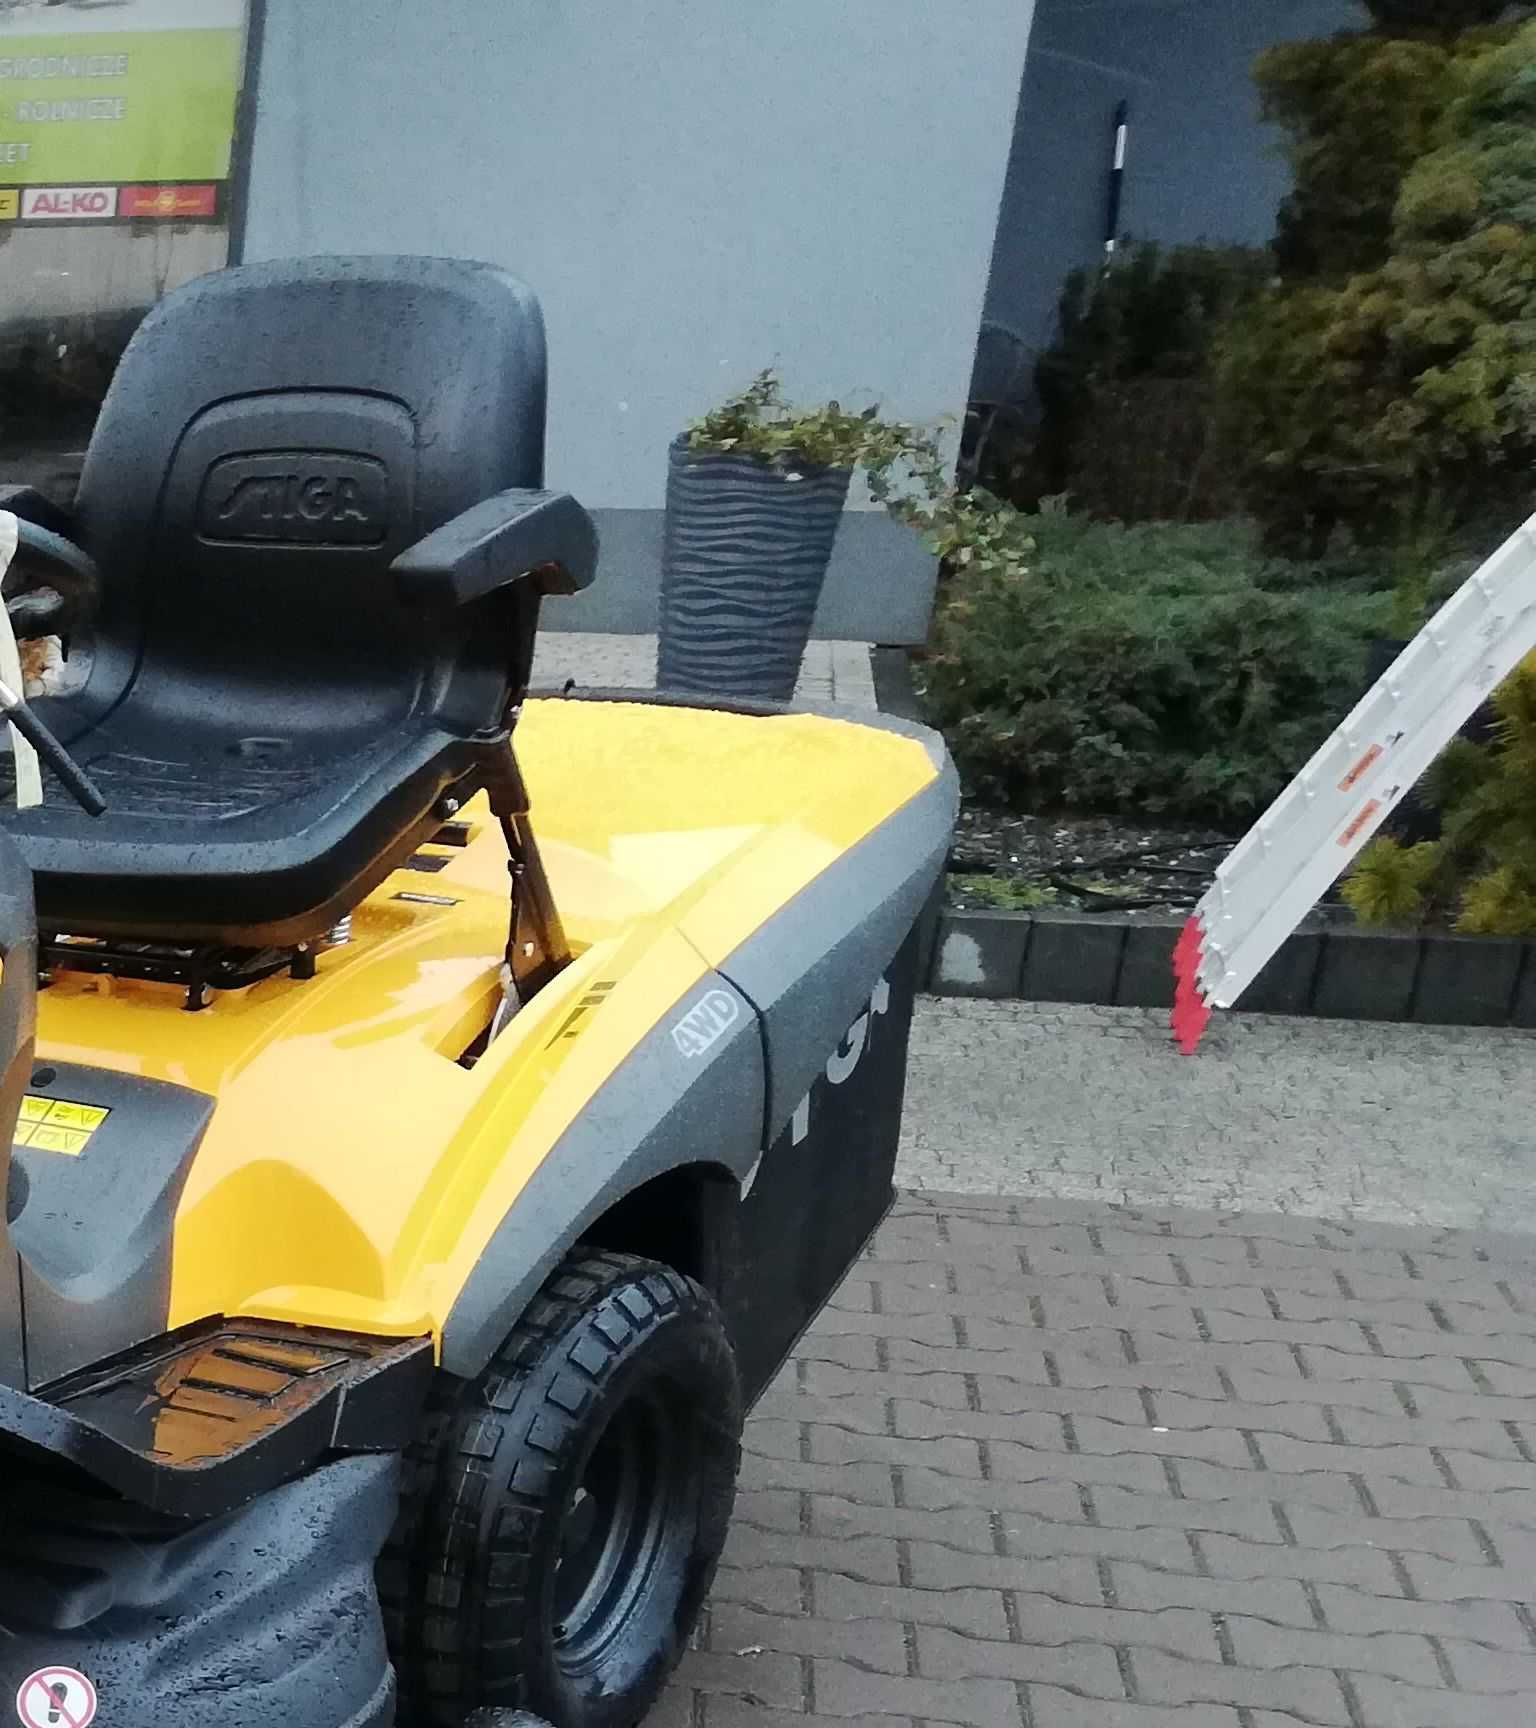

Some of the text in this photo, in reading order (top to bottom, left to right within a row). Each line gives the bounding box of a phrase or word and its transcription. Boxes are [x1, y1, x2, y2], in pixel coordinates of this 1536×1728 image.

[31, 192, 109, 214] AL-KO
[219, 473, 369, 521] STIGA
[671, 990, 738, 1057] 4WD
